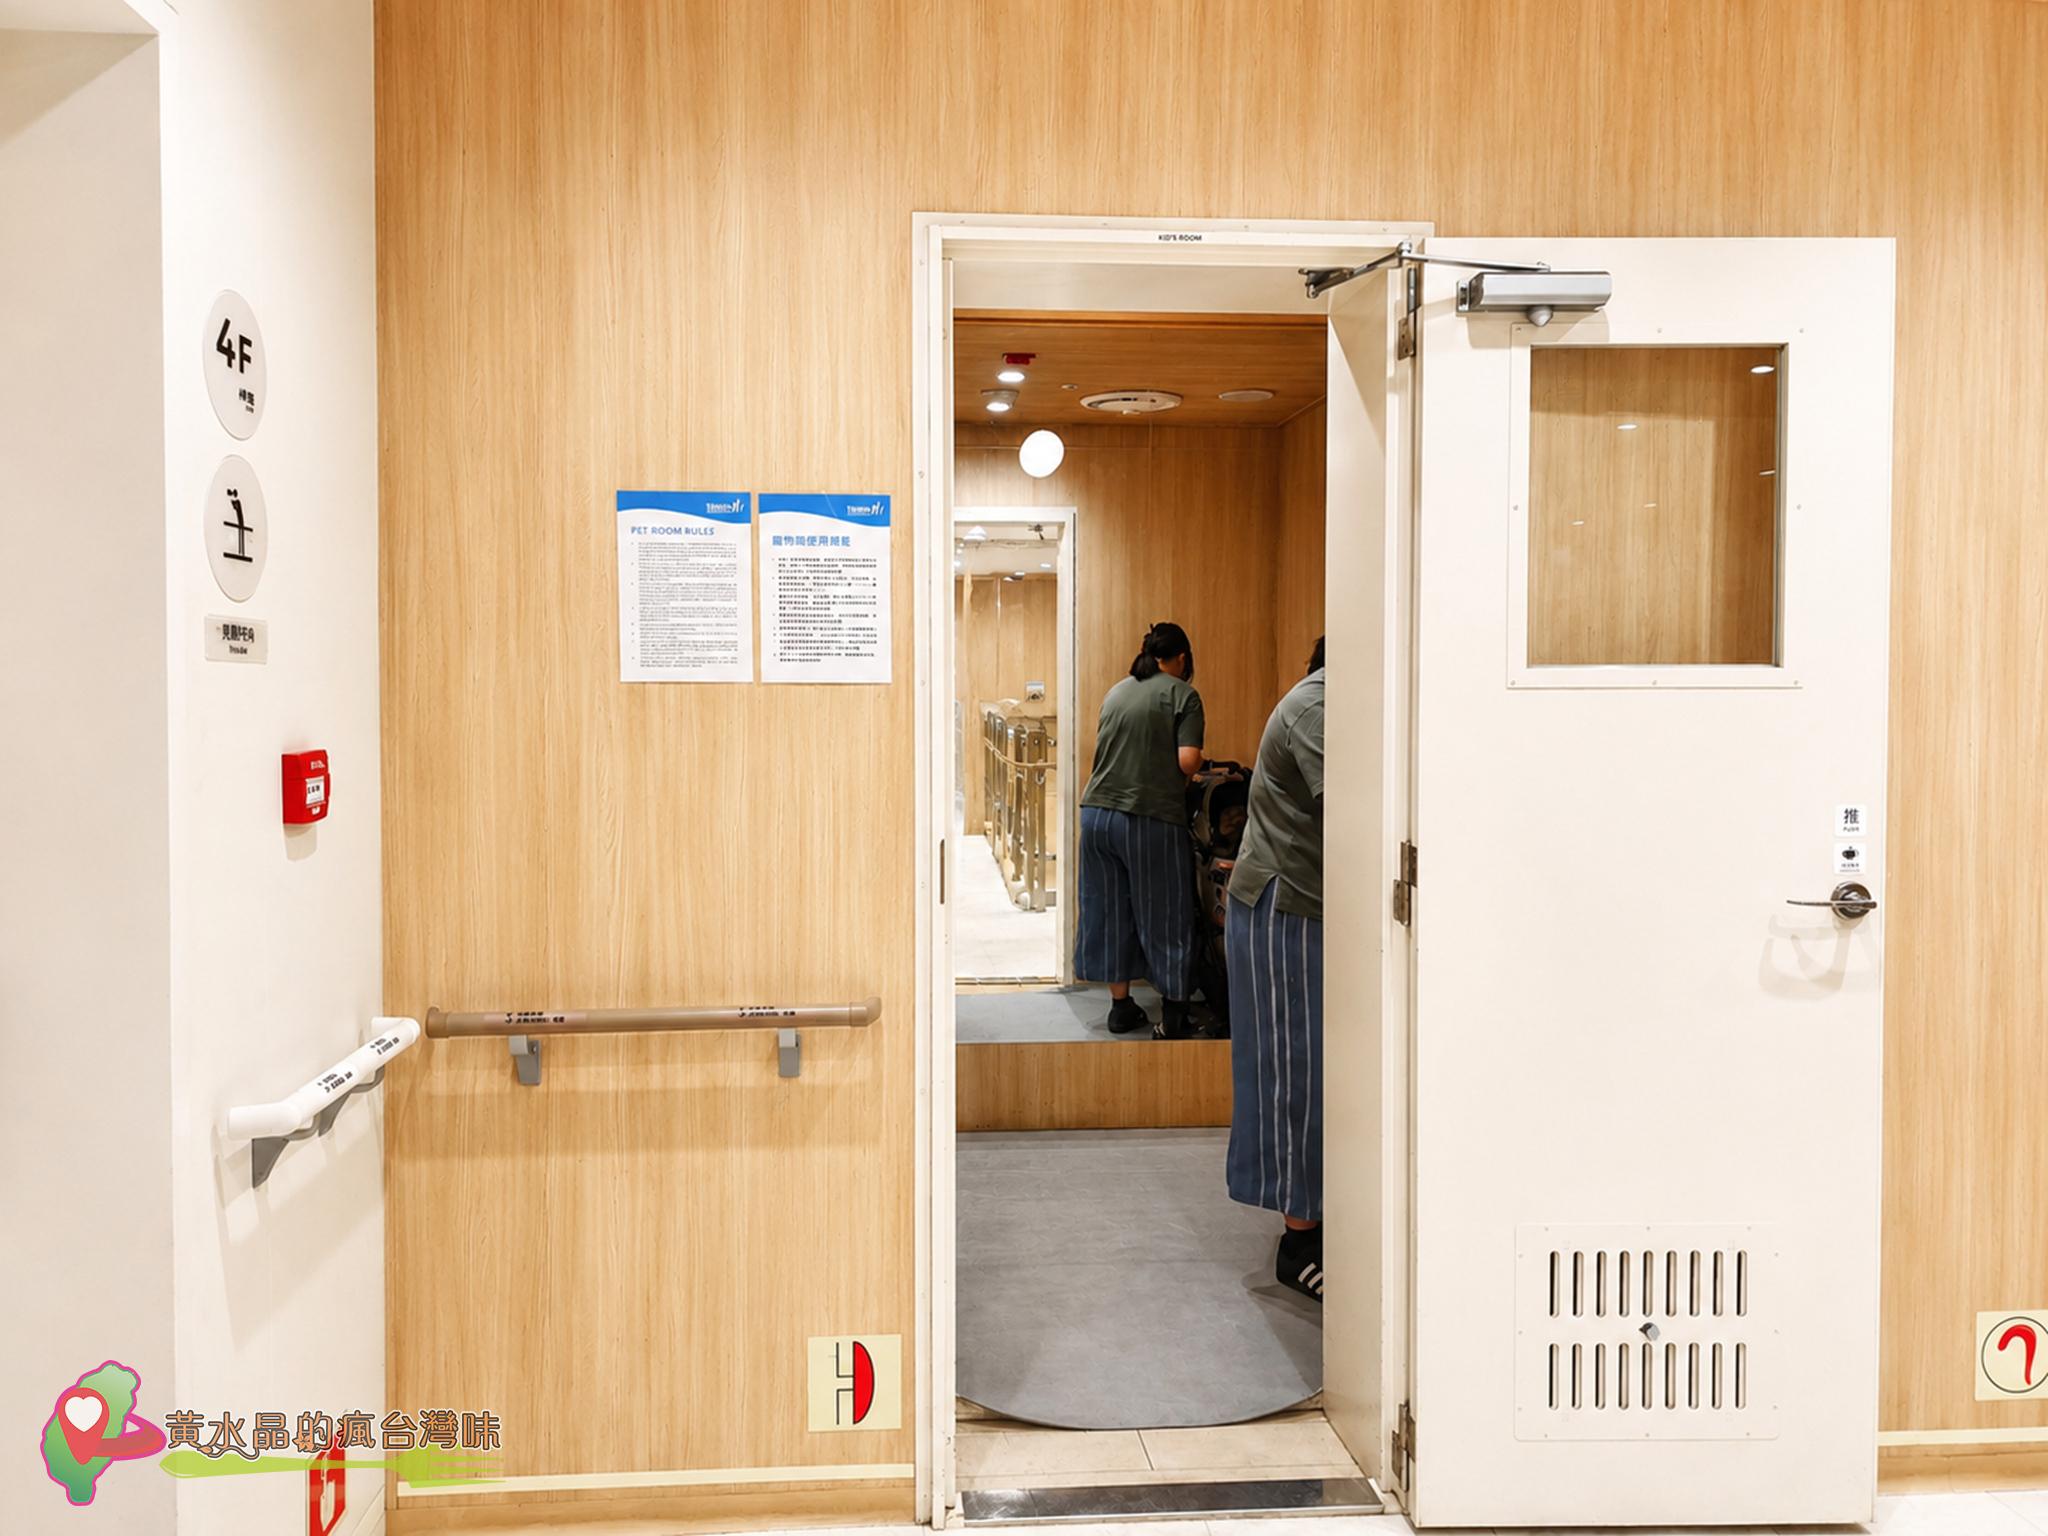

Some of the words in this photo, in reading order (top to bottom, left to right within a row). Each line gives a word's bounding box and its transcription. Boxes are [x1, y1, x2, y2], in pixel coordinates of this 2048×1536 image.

[215, 317, 253, 375] 4F
[630, 526, 649, 536] PET
[651, 526, 683, 536] ROOM
[684, 526, 715, 537] RULES
[1843, 807, 1860, 825] 推
